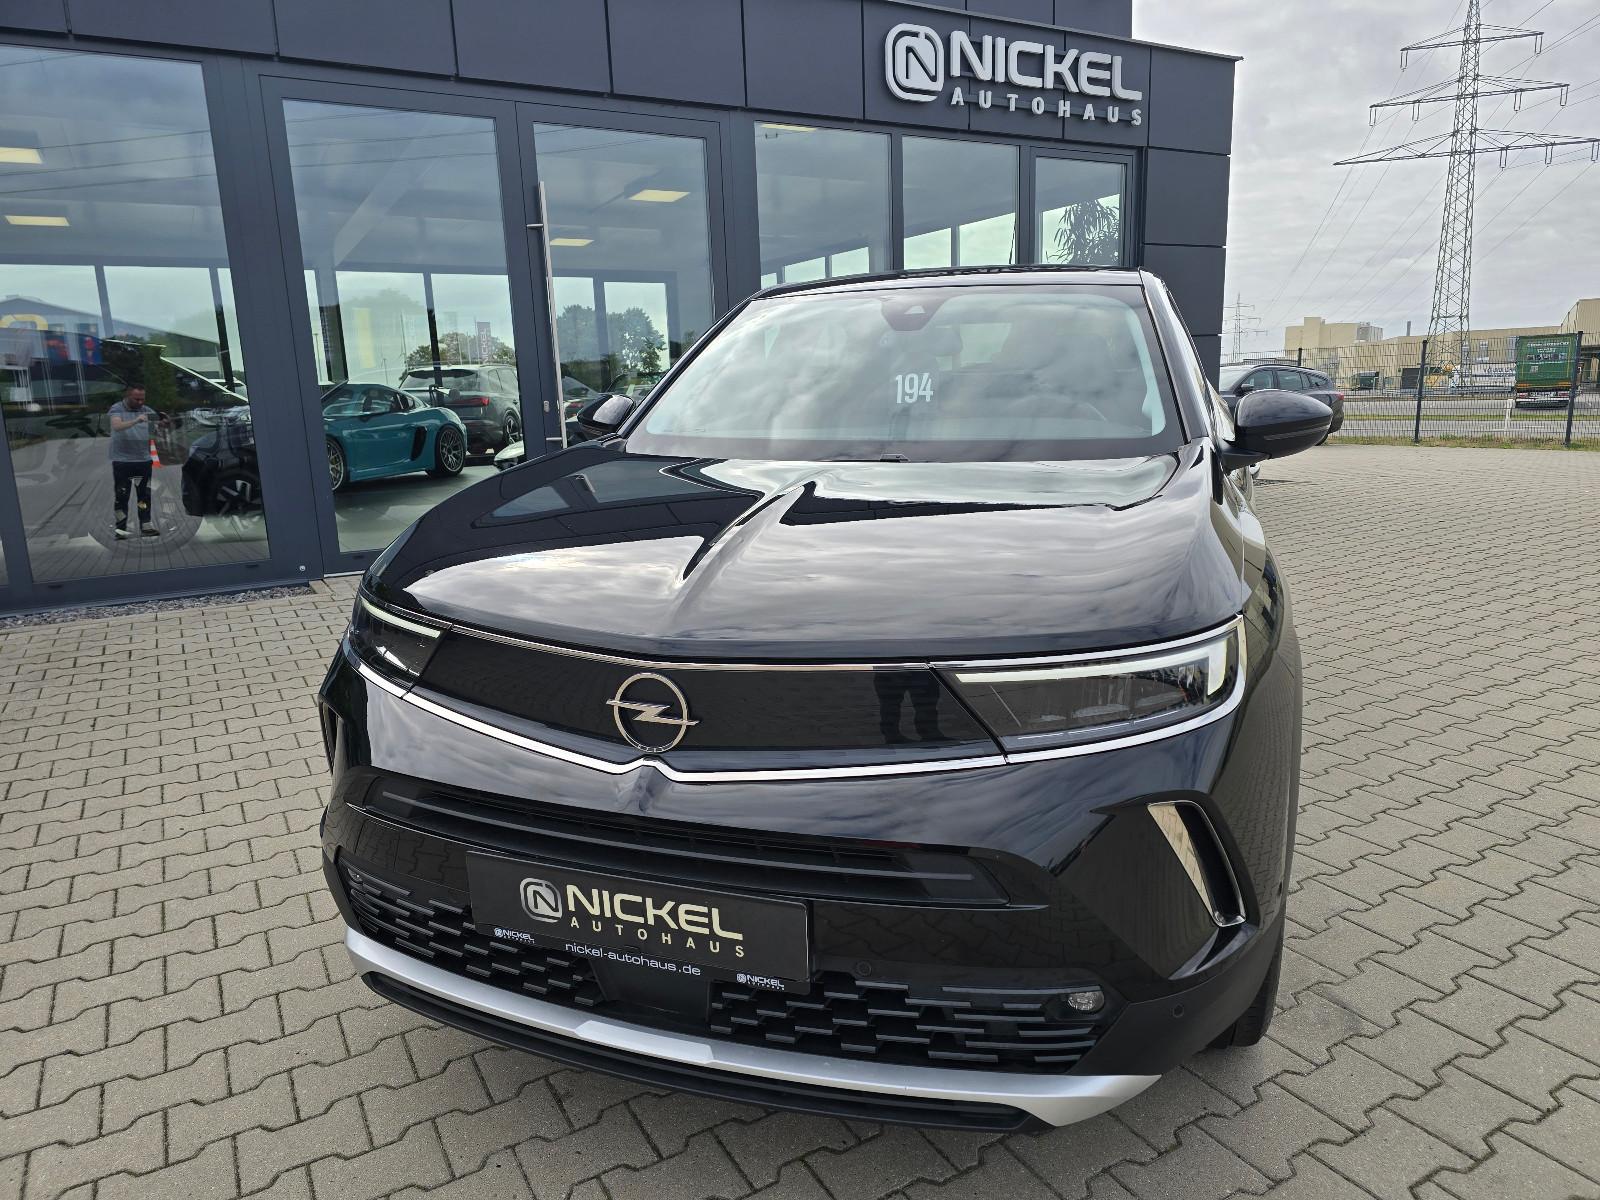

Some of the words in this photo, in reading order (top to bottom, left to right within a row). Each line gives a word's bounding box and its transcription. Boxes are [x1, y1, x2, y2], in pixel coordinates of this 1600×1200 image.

[950, 30, 1143, 101] NICKEL
[951, 87, 1142, 126] AUTOHAUS
[895, 373, 934, 404] 194
[566, 884, 744, 941] NICKEL
[502, 929, 535, 941] NICKEL
[570, 916, 745, 958] AUTOHAUS
[565, 942, 701, 976] nickel-autohaus.de
[747, 974, 785, 988] NICKEL
